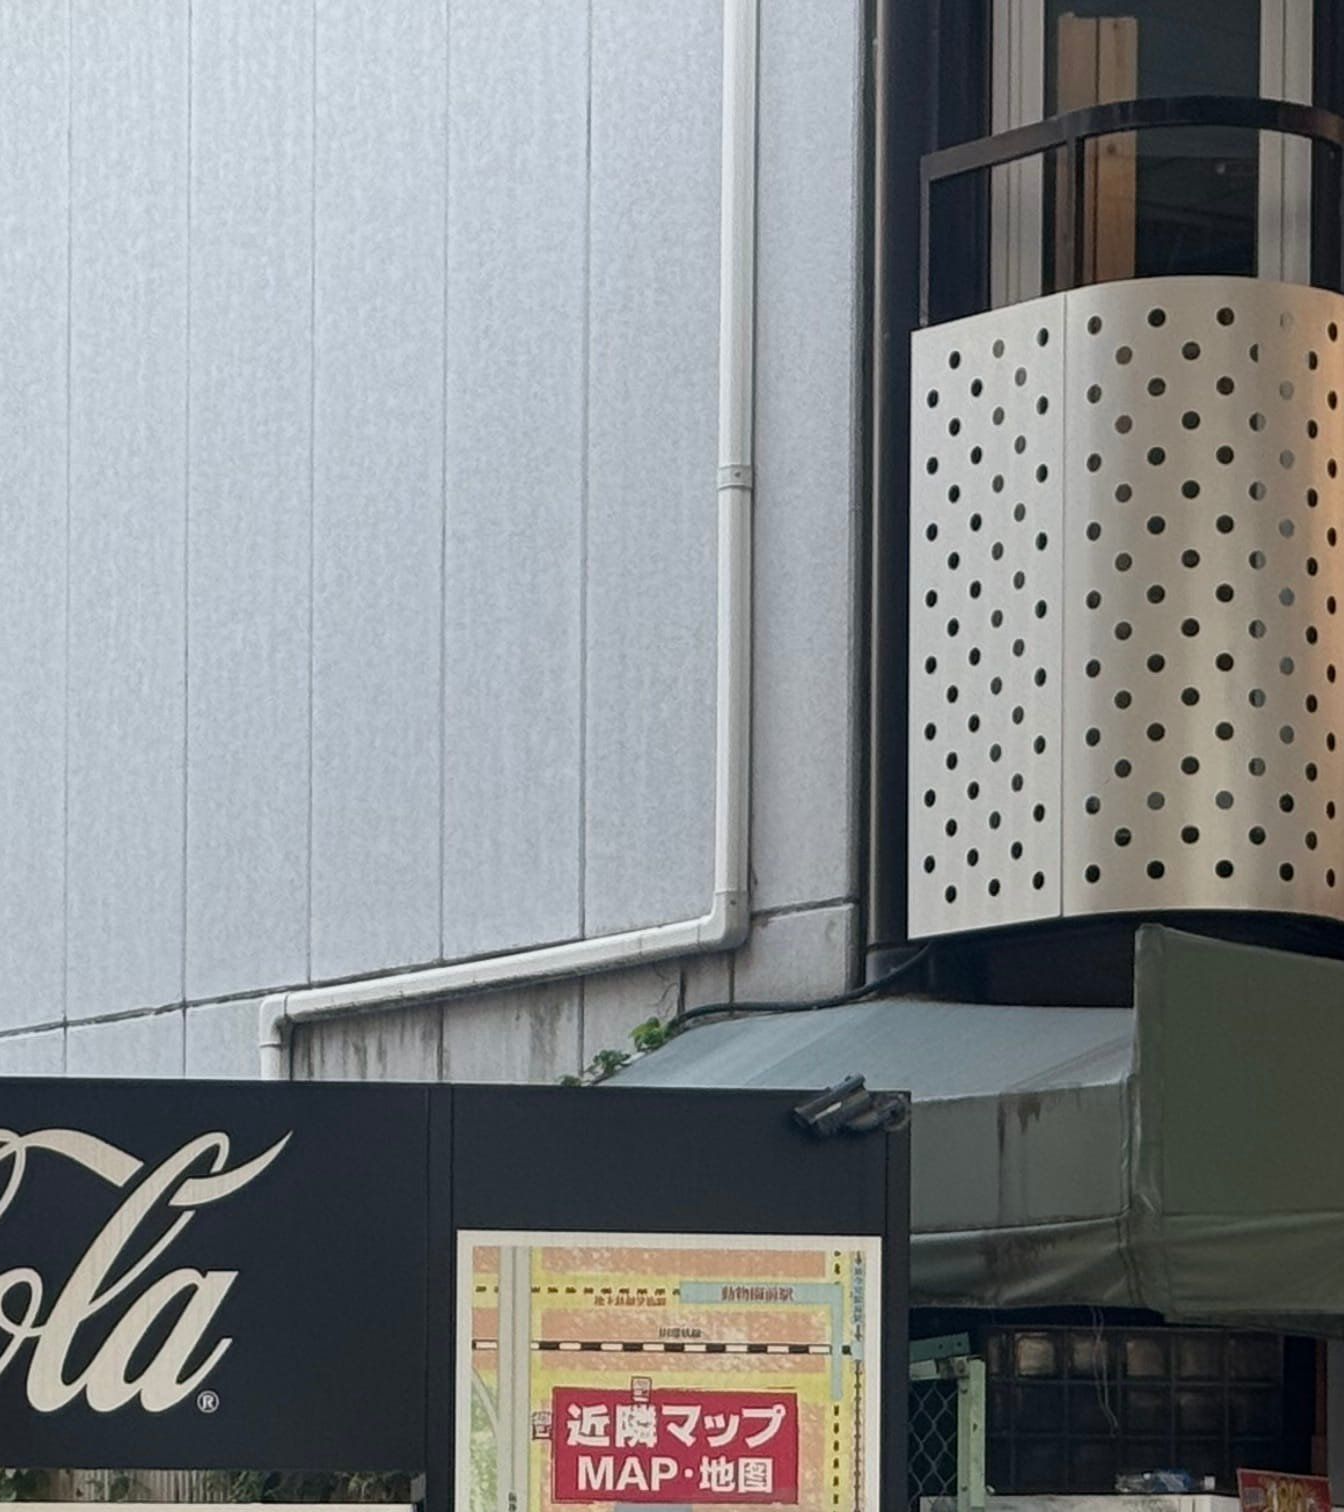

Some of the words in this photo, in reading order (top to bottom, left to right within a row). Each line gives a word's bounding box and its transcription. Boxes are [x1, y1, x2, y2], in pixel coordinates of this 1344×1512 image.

[567, 1402, 787, 1449] 近隣マップ
